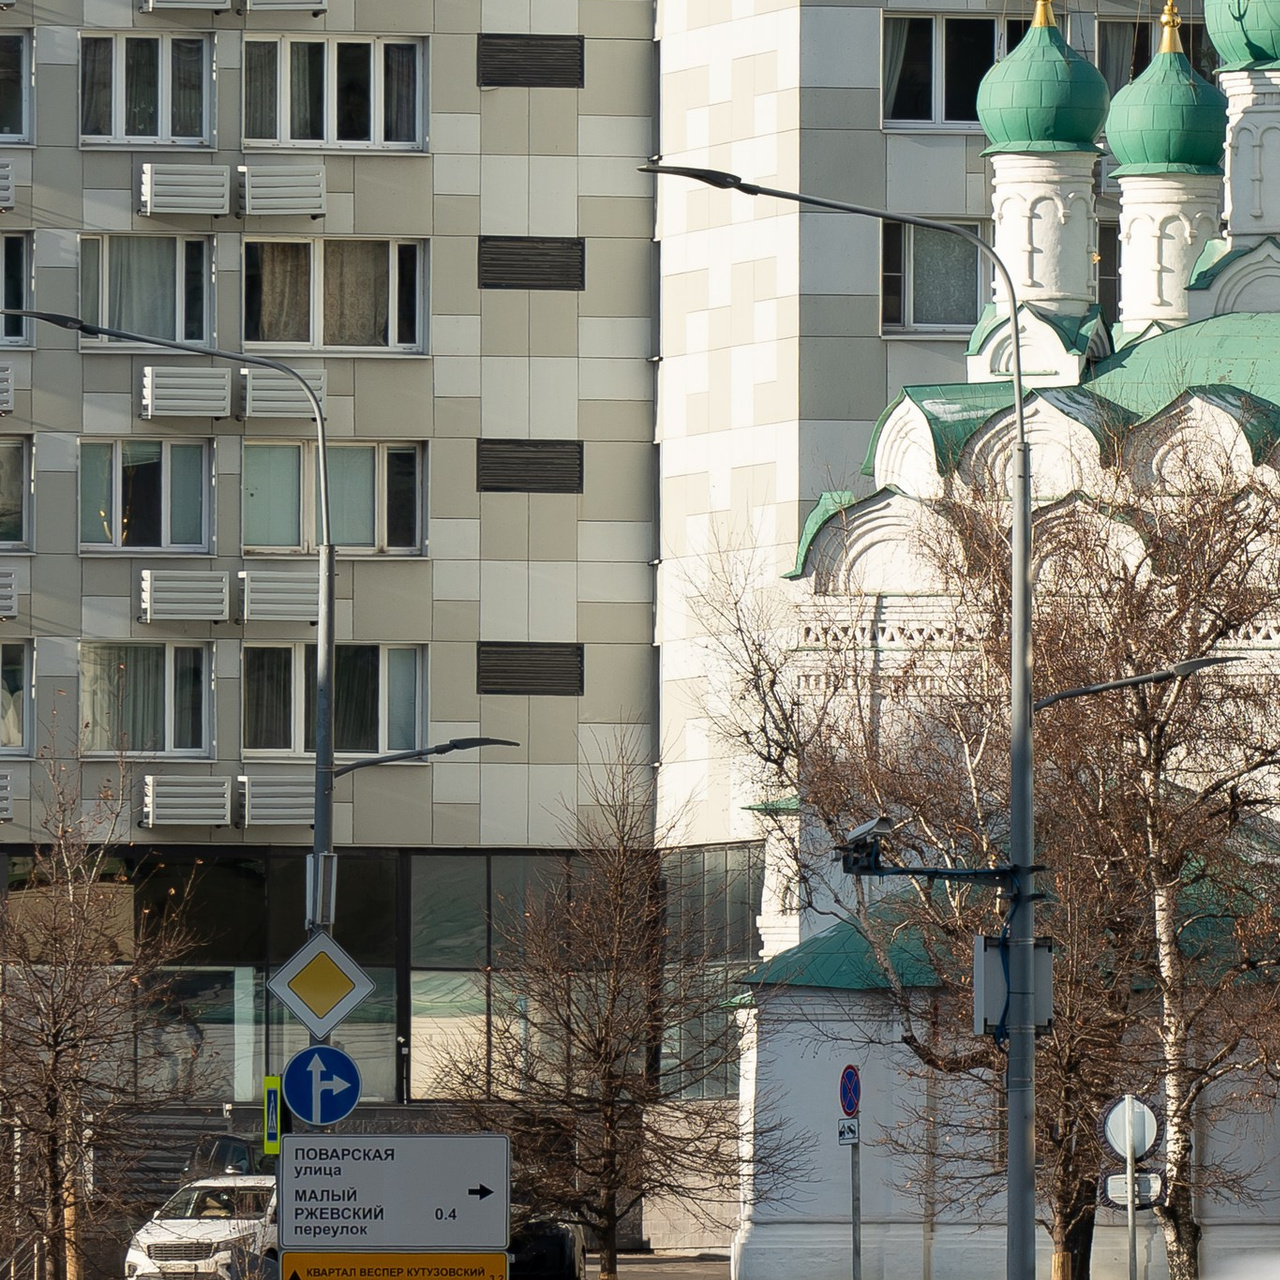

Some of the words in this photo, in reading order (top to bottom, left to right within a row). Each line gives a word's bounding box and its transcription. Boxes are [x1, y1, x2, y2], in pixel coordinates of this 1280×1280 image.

[294, 1148, 395, 1161] ПОВАРСКАЯ
[294, 1166, 342, 1179] улица
[294, 1186, 357, 1202] МАЛЫЙ
[294, 1205, 384, 1220] РЖЕВСКИЙ
[434, 1208, 457, 1221] 0.4
[294, 1225, 368, 1238] переулок
[306, 1268, 356, 1277] КВАРТАЛ
[360, 1268, 404, 1277] ВЕСПЕР
[407, 1267, 485, 1277] КУТУЗОВСКИЙ
